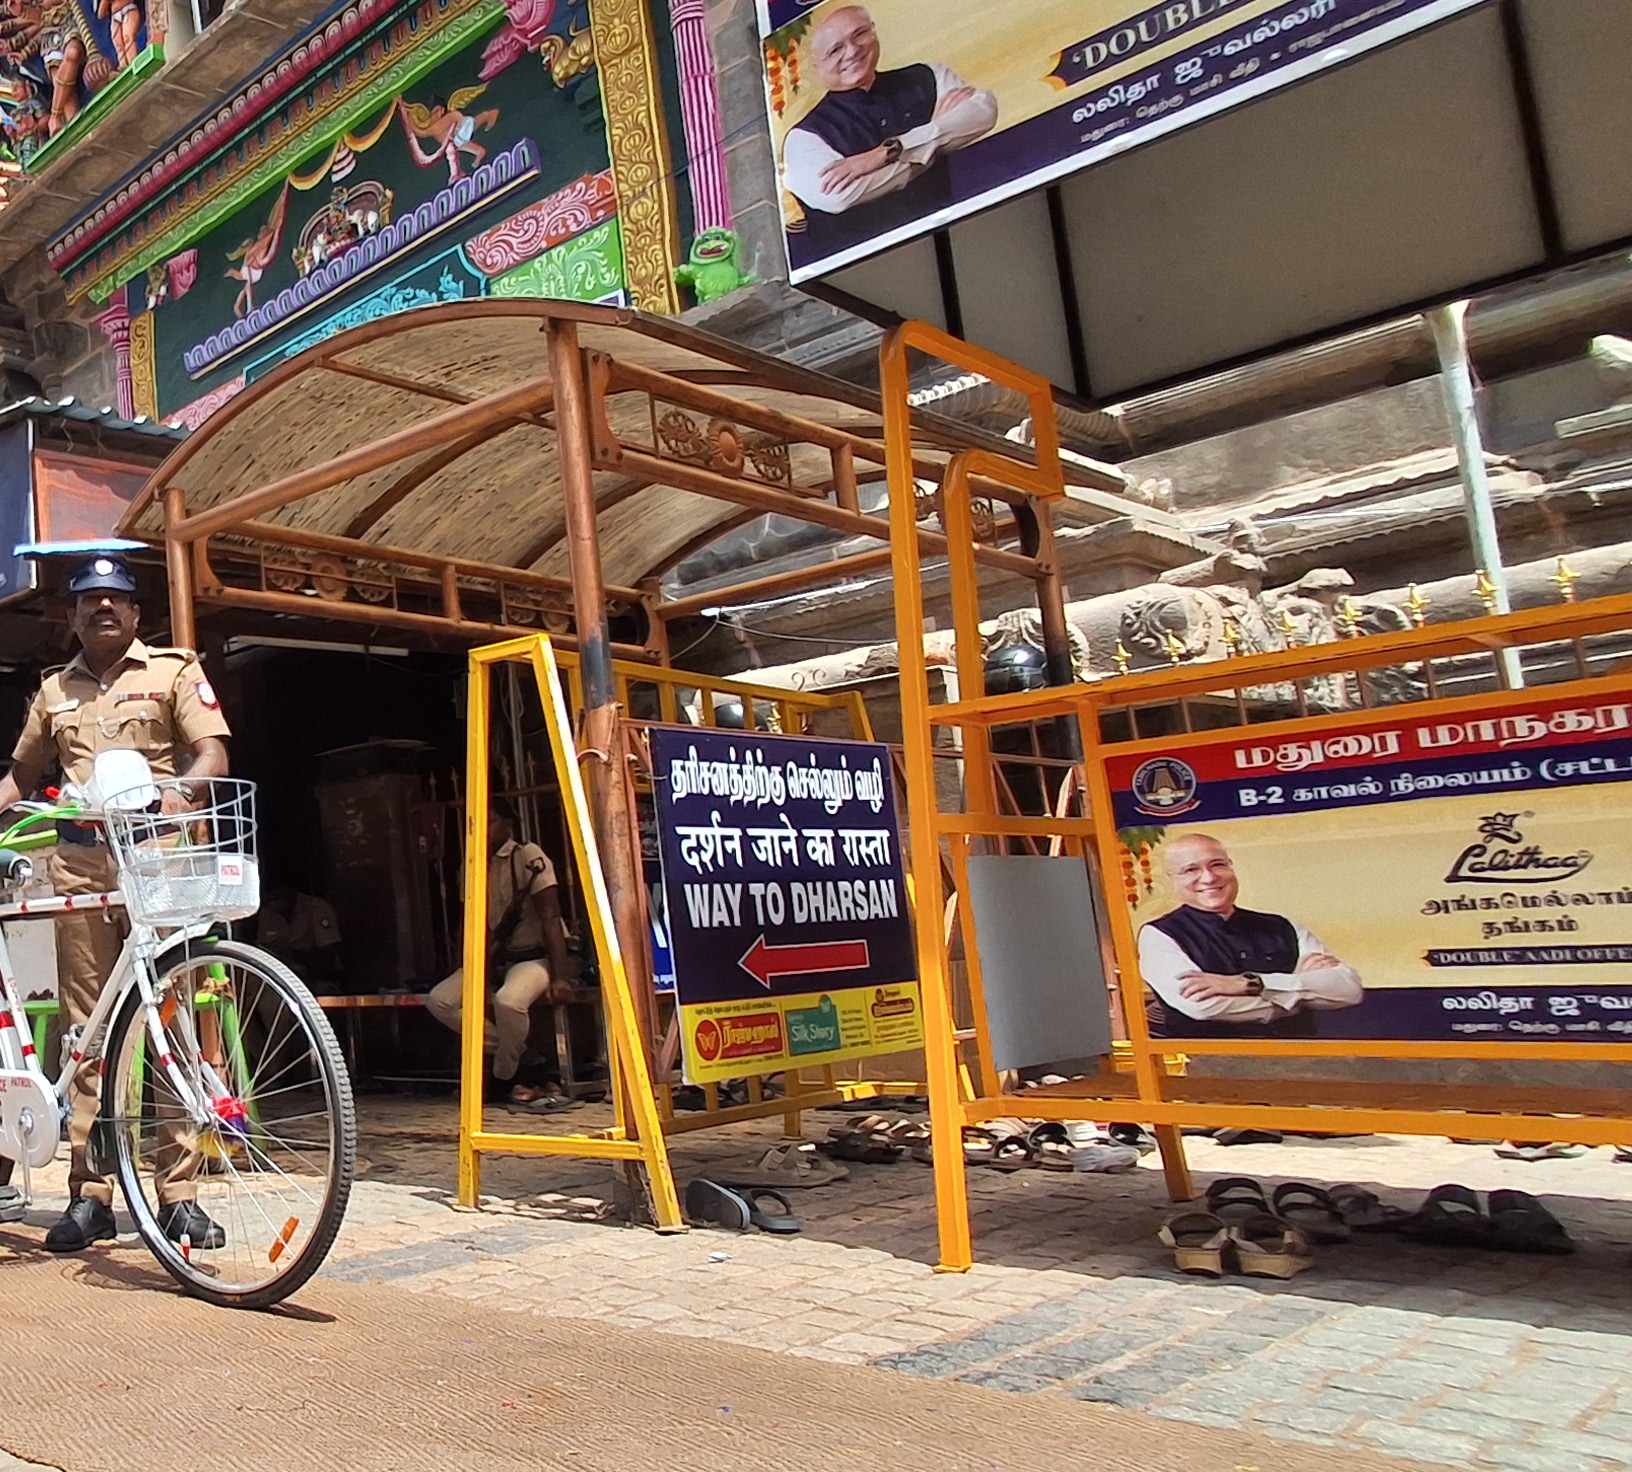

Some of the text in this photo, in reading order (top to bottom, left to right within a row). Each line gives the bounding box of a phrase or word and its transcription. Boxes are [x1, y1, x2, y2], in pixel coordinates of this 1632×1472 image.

[1072, 0, 1230, 71] ‘DOUBL
[1071, 73, 1161, 124] லலிதா
[1234, 728, 1402, 772] மதுரை
[671, 745, 885, 814] தரிசனத்திற்கு செல்லும் வழி
[1238, 787, 1285, 807] B-2
[1292, 775, 1384, 802] காவல்
[1389, 760, 1532, 797] நிலையம்
[674, 811, 891, 874] दर्शन जाने का रास्ता
[684, 882, 743, 928] WAY
[749, 882, 785, 926] TO
[790, 879, 898, 923] DHARSAN
[1481, 914, 1579, 940] தங்கம்
[1527, 950, 1574, 963] AADI
[1442, 990, 1535, 1015] லலிதா
[791, 1023, 836, 1042] Silk Story
[10, 1076, 33, 1088] PATROL
